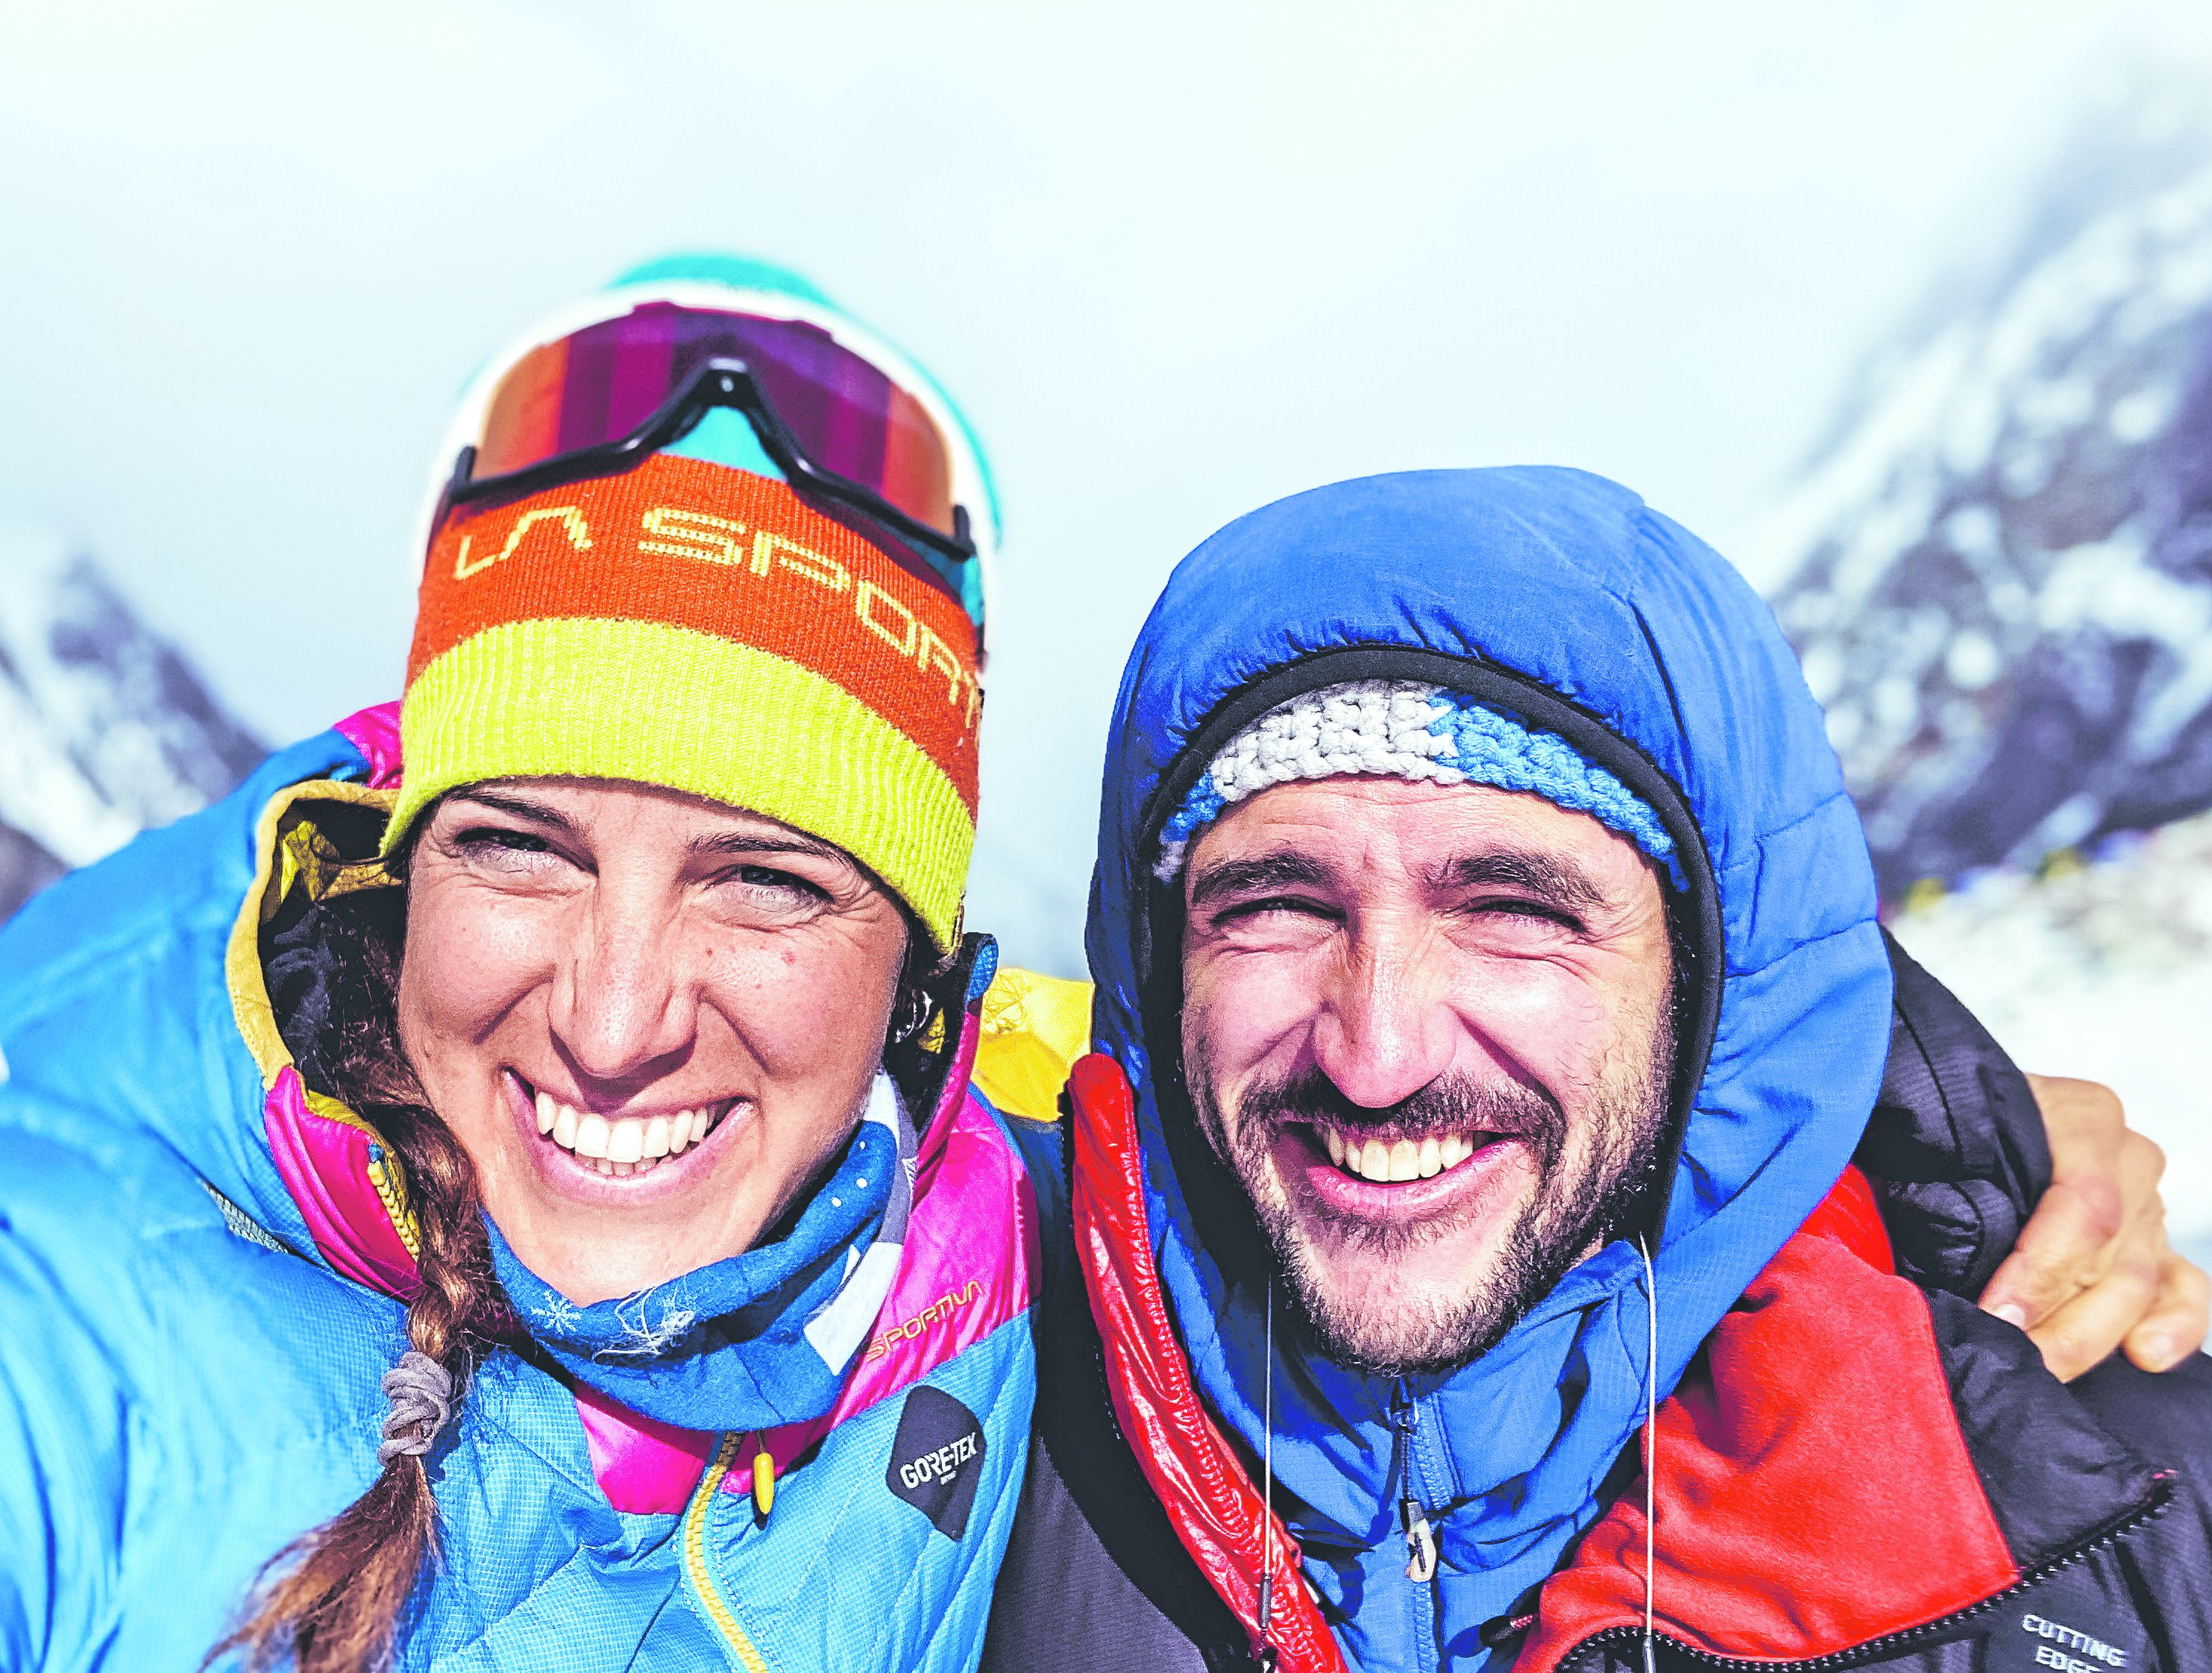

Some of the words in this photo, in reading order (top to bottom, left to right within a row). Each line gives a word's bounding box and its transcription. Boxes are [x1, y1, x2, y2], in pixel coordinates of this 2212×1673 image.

[454, 506, 593, 580] LA
[866, 1280, 984, 1363] SPORTIVA
[899, 1431, 977, 1490] GORE-TEX
[2022, 1614, 2128, 1668] CUTTING
